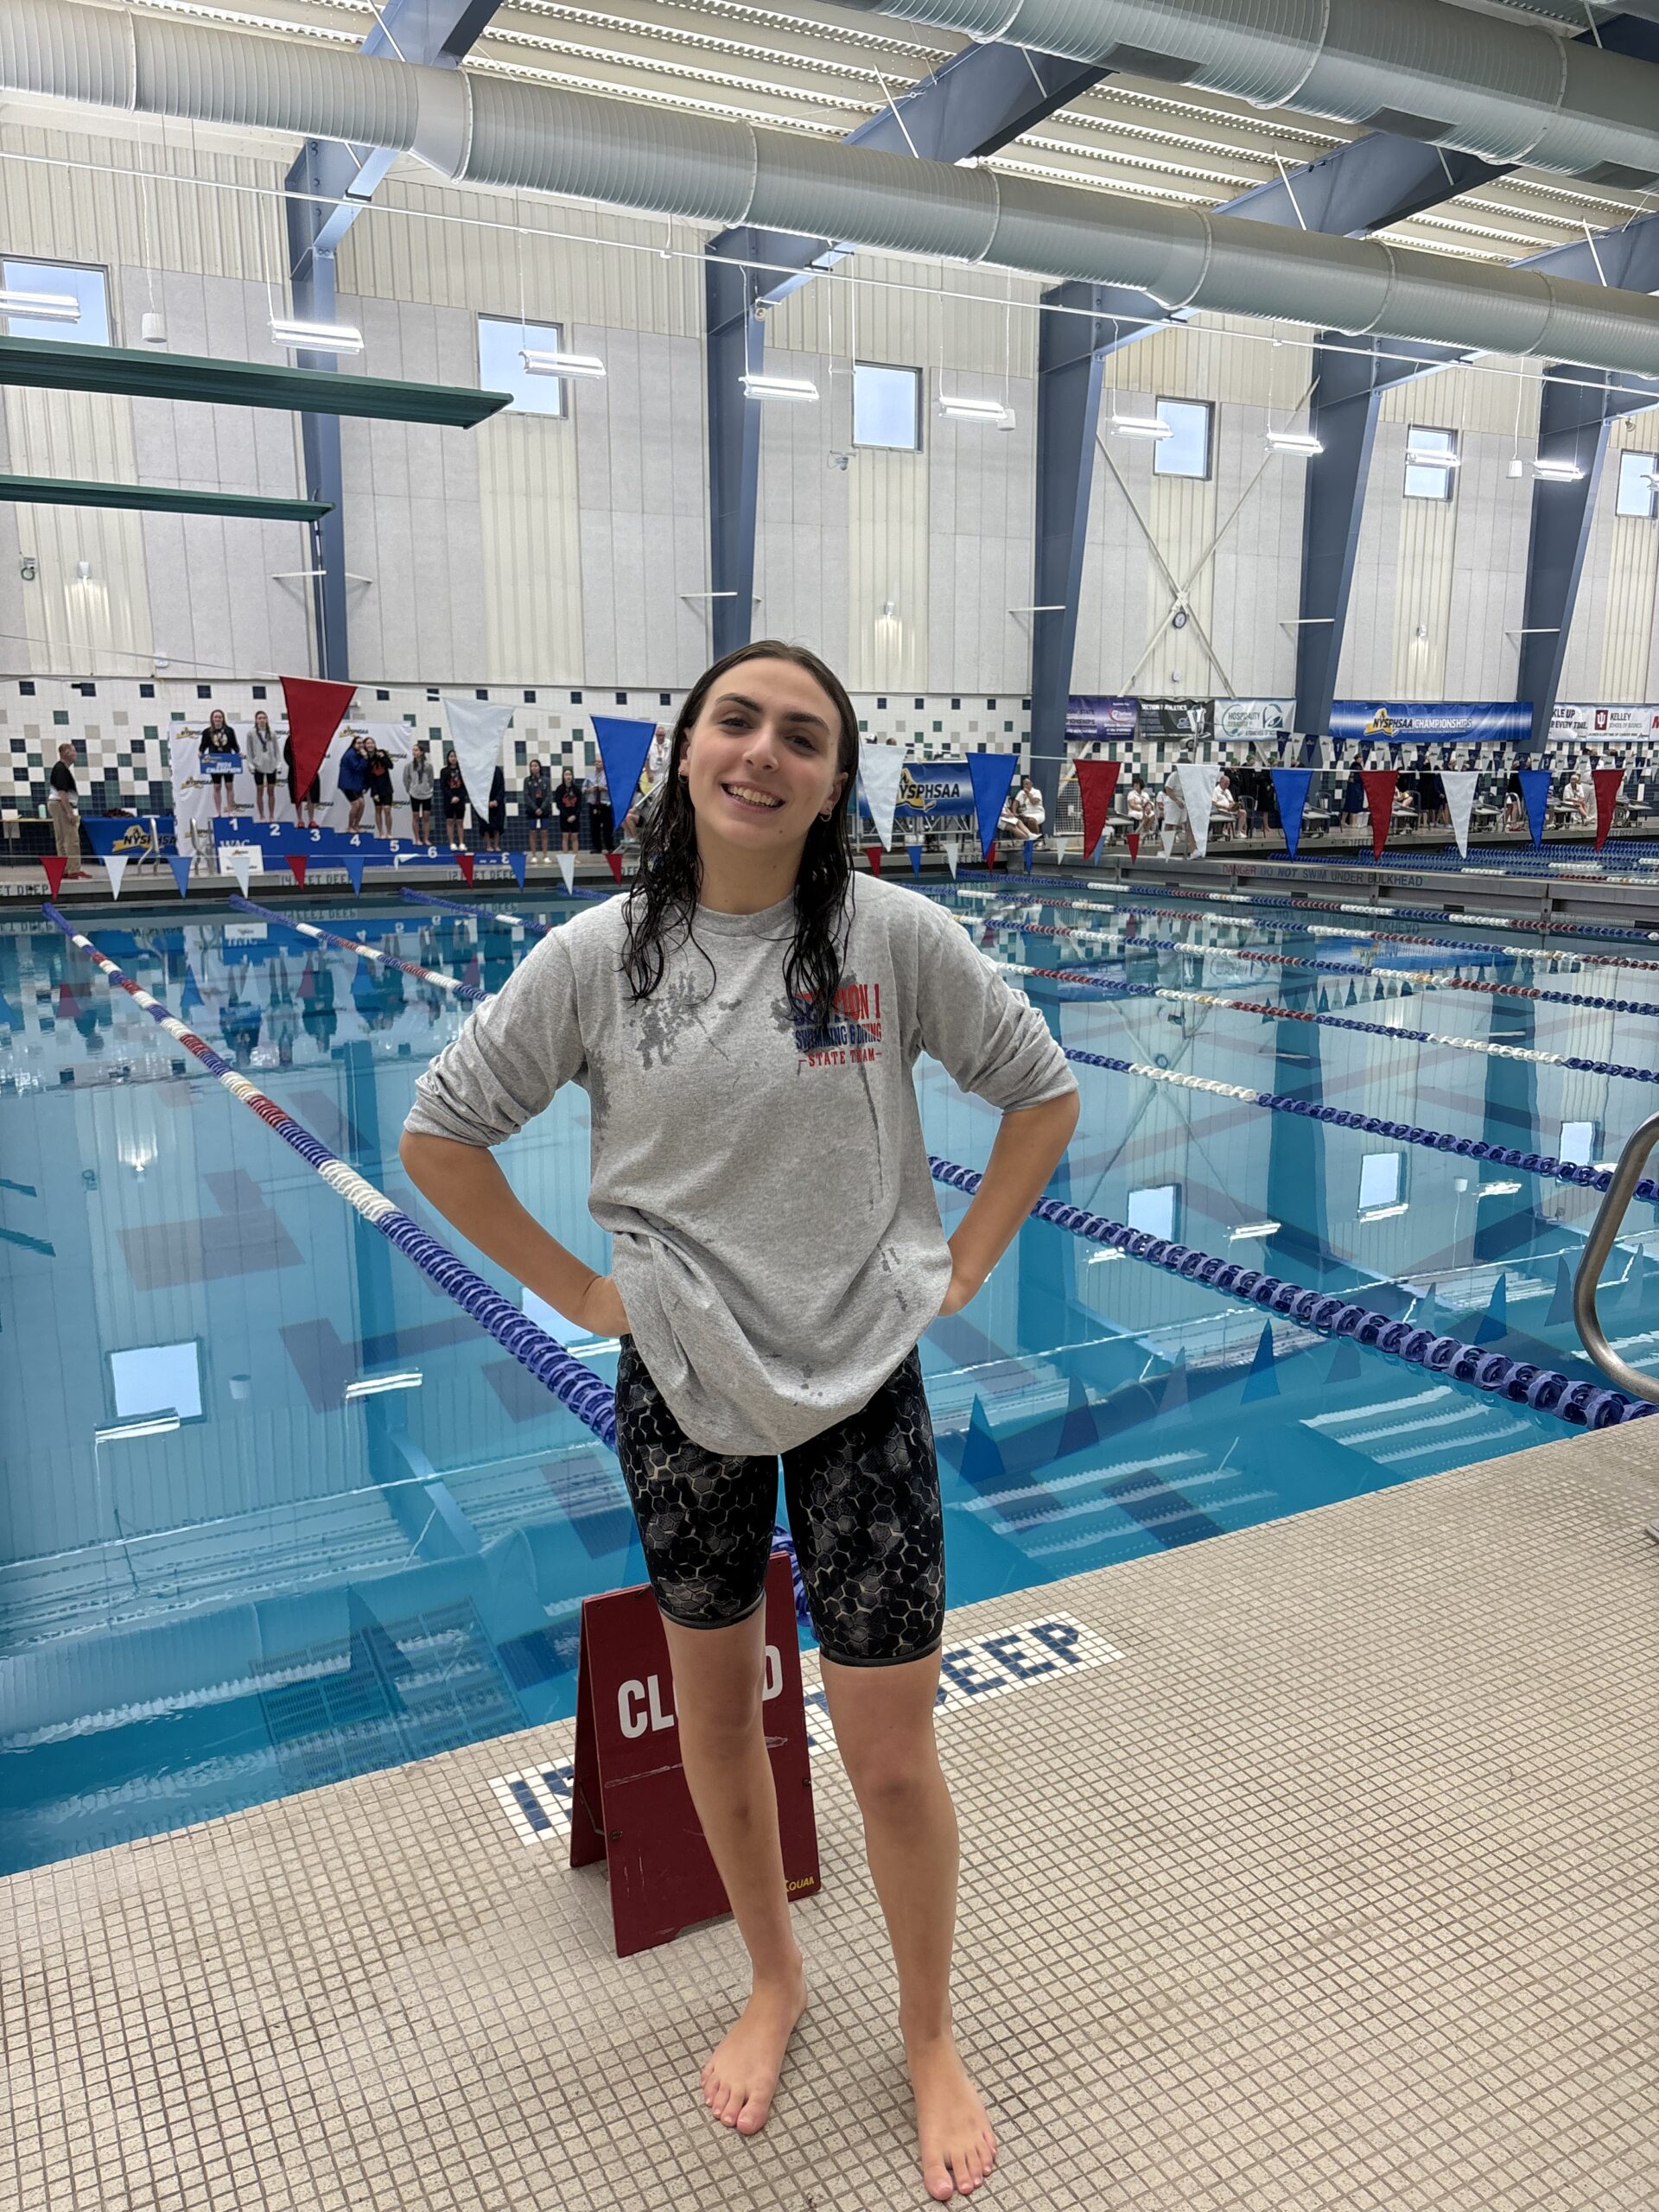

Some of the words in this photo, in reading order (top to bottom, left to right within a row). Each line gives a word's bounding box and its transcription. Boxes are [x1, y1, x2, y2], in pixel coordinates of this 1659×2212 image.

[1566, 709, 1576, 719] UP
[1610, 713, 1631, 721] KELLEY
[1373, 718, 1413, 728] NYSPHSAA
[1414, 718, 1472, 729] CHAMPIONSHIPS
[899, 784, 961, 798] YSPHSAA
[229, 817, 238, 831] 1
[269, 823, 281, 836] 2
[309, 829, 321, 842] 3
[349, 834, 361, 847] 4
[389, 839, 400, 852] 5
[427, 845, 438, 859] 6
[327, 873, 351, 885] DEE
[1223, 865, 1256, 876] DANGER
[1260, 866, 1274, 876] DO
[1277, 867, 1298, 878] NOT
[1302, 868, 1327, 880] SWIM
[1331, 870, 1363, 883] UNDER
[1368, 873, 1424, 887] BULKHEAD
[856, 1022, 882, 1045] DIVING
[808, 1051, 846, 1067] STATE
[849, 1047, 875, 1064] TEAM
[933, 1623, 1080, 1707] EEP
[617, 1644, 785, 1739] CLD
